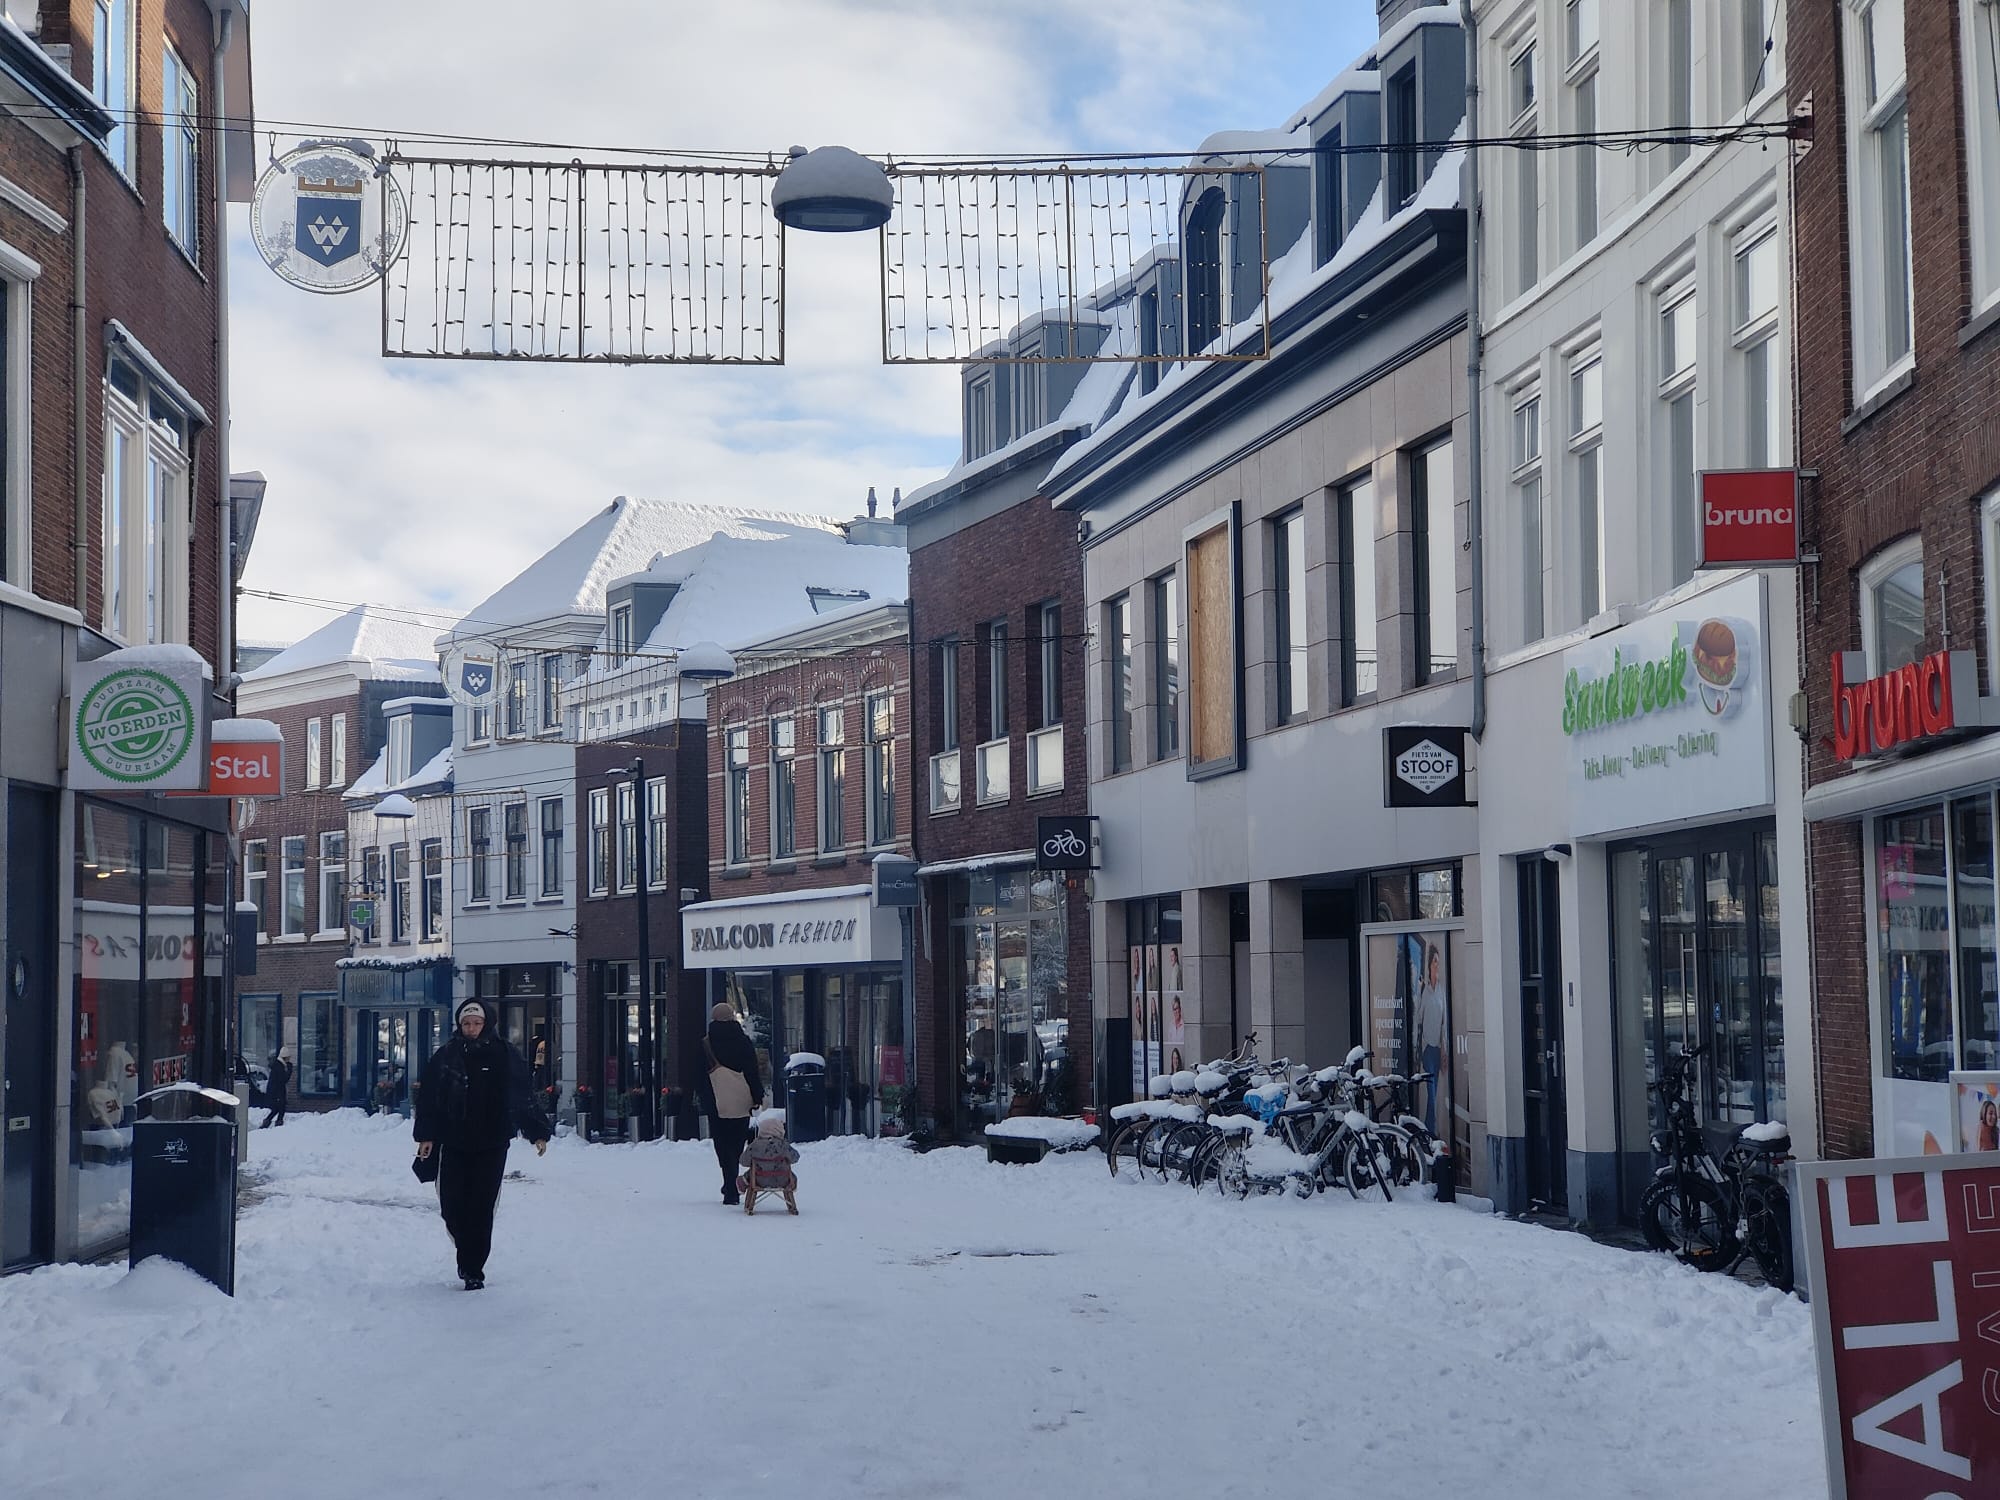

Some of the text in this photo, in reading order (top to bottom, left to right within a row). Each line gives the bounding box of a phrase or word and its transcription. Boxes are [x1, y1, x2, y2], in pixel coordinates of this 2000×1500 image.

[1705, 501, 1792, 526] bruna
[93, 679, 165, 709] DUURZAAM
[1831, 650, 1954, 762] bruna
[88, 708, 182, 741] WOERDEN
[106, 742, 177, 772] DUURZAAM
[211, 754, 272, 780] Stal
[1401, 760, 1453, 774] STOOF
[690, 917, 857, 952] FALCON FASHION
[1827, 1171, 1973, 1500] ALE
